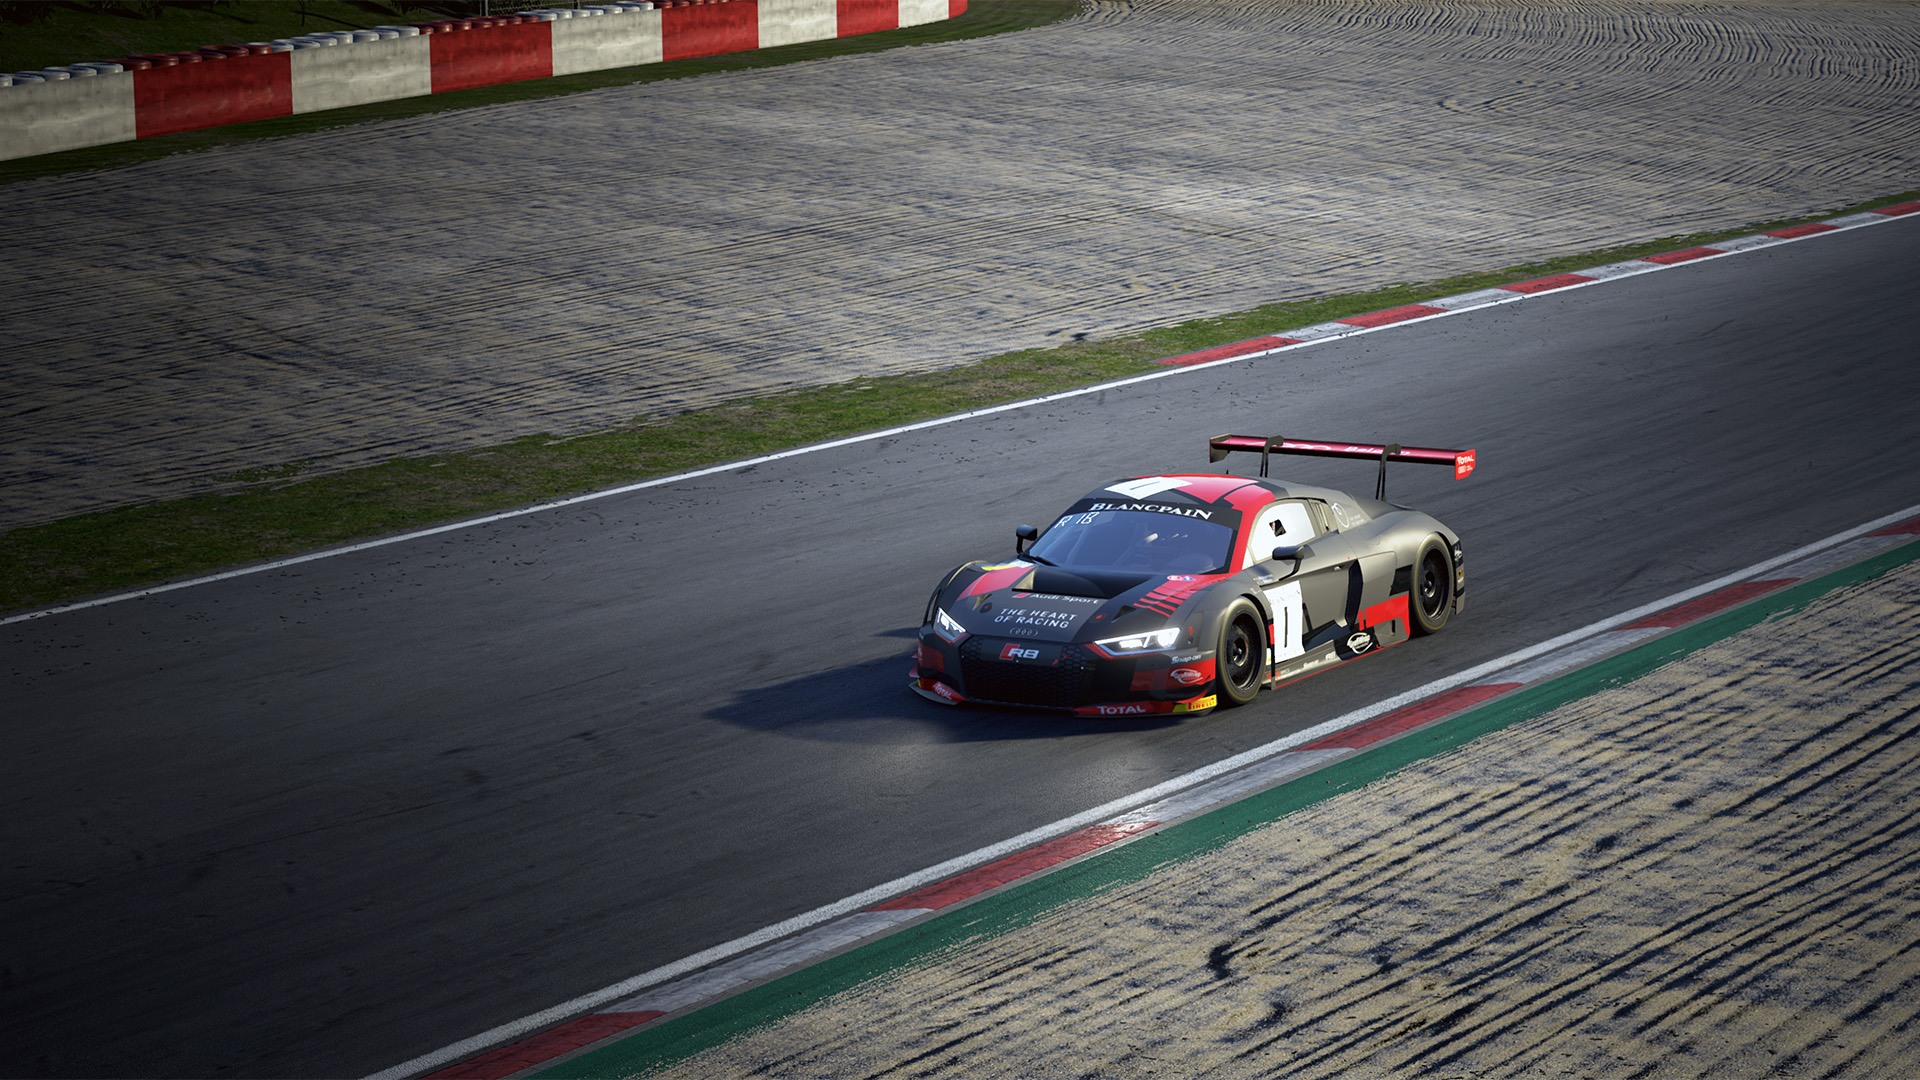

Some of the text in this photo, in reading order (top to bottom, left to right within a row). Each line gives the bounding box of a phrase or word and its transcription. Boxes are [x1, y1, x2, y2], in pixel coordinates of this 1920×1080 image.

[1088, 502, 1214, 521] BLANCPAIN
[1029, 593, 1100, 605] Audi Sport
[1001, 608, 1077, 621] THE HEART
[994, 615, 1070, 629] OF RACING
[1007, 647, 1040, 660] R8
[1097, 704, 1146, 715] TOTAL
